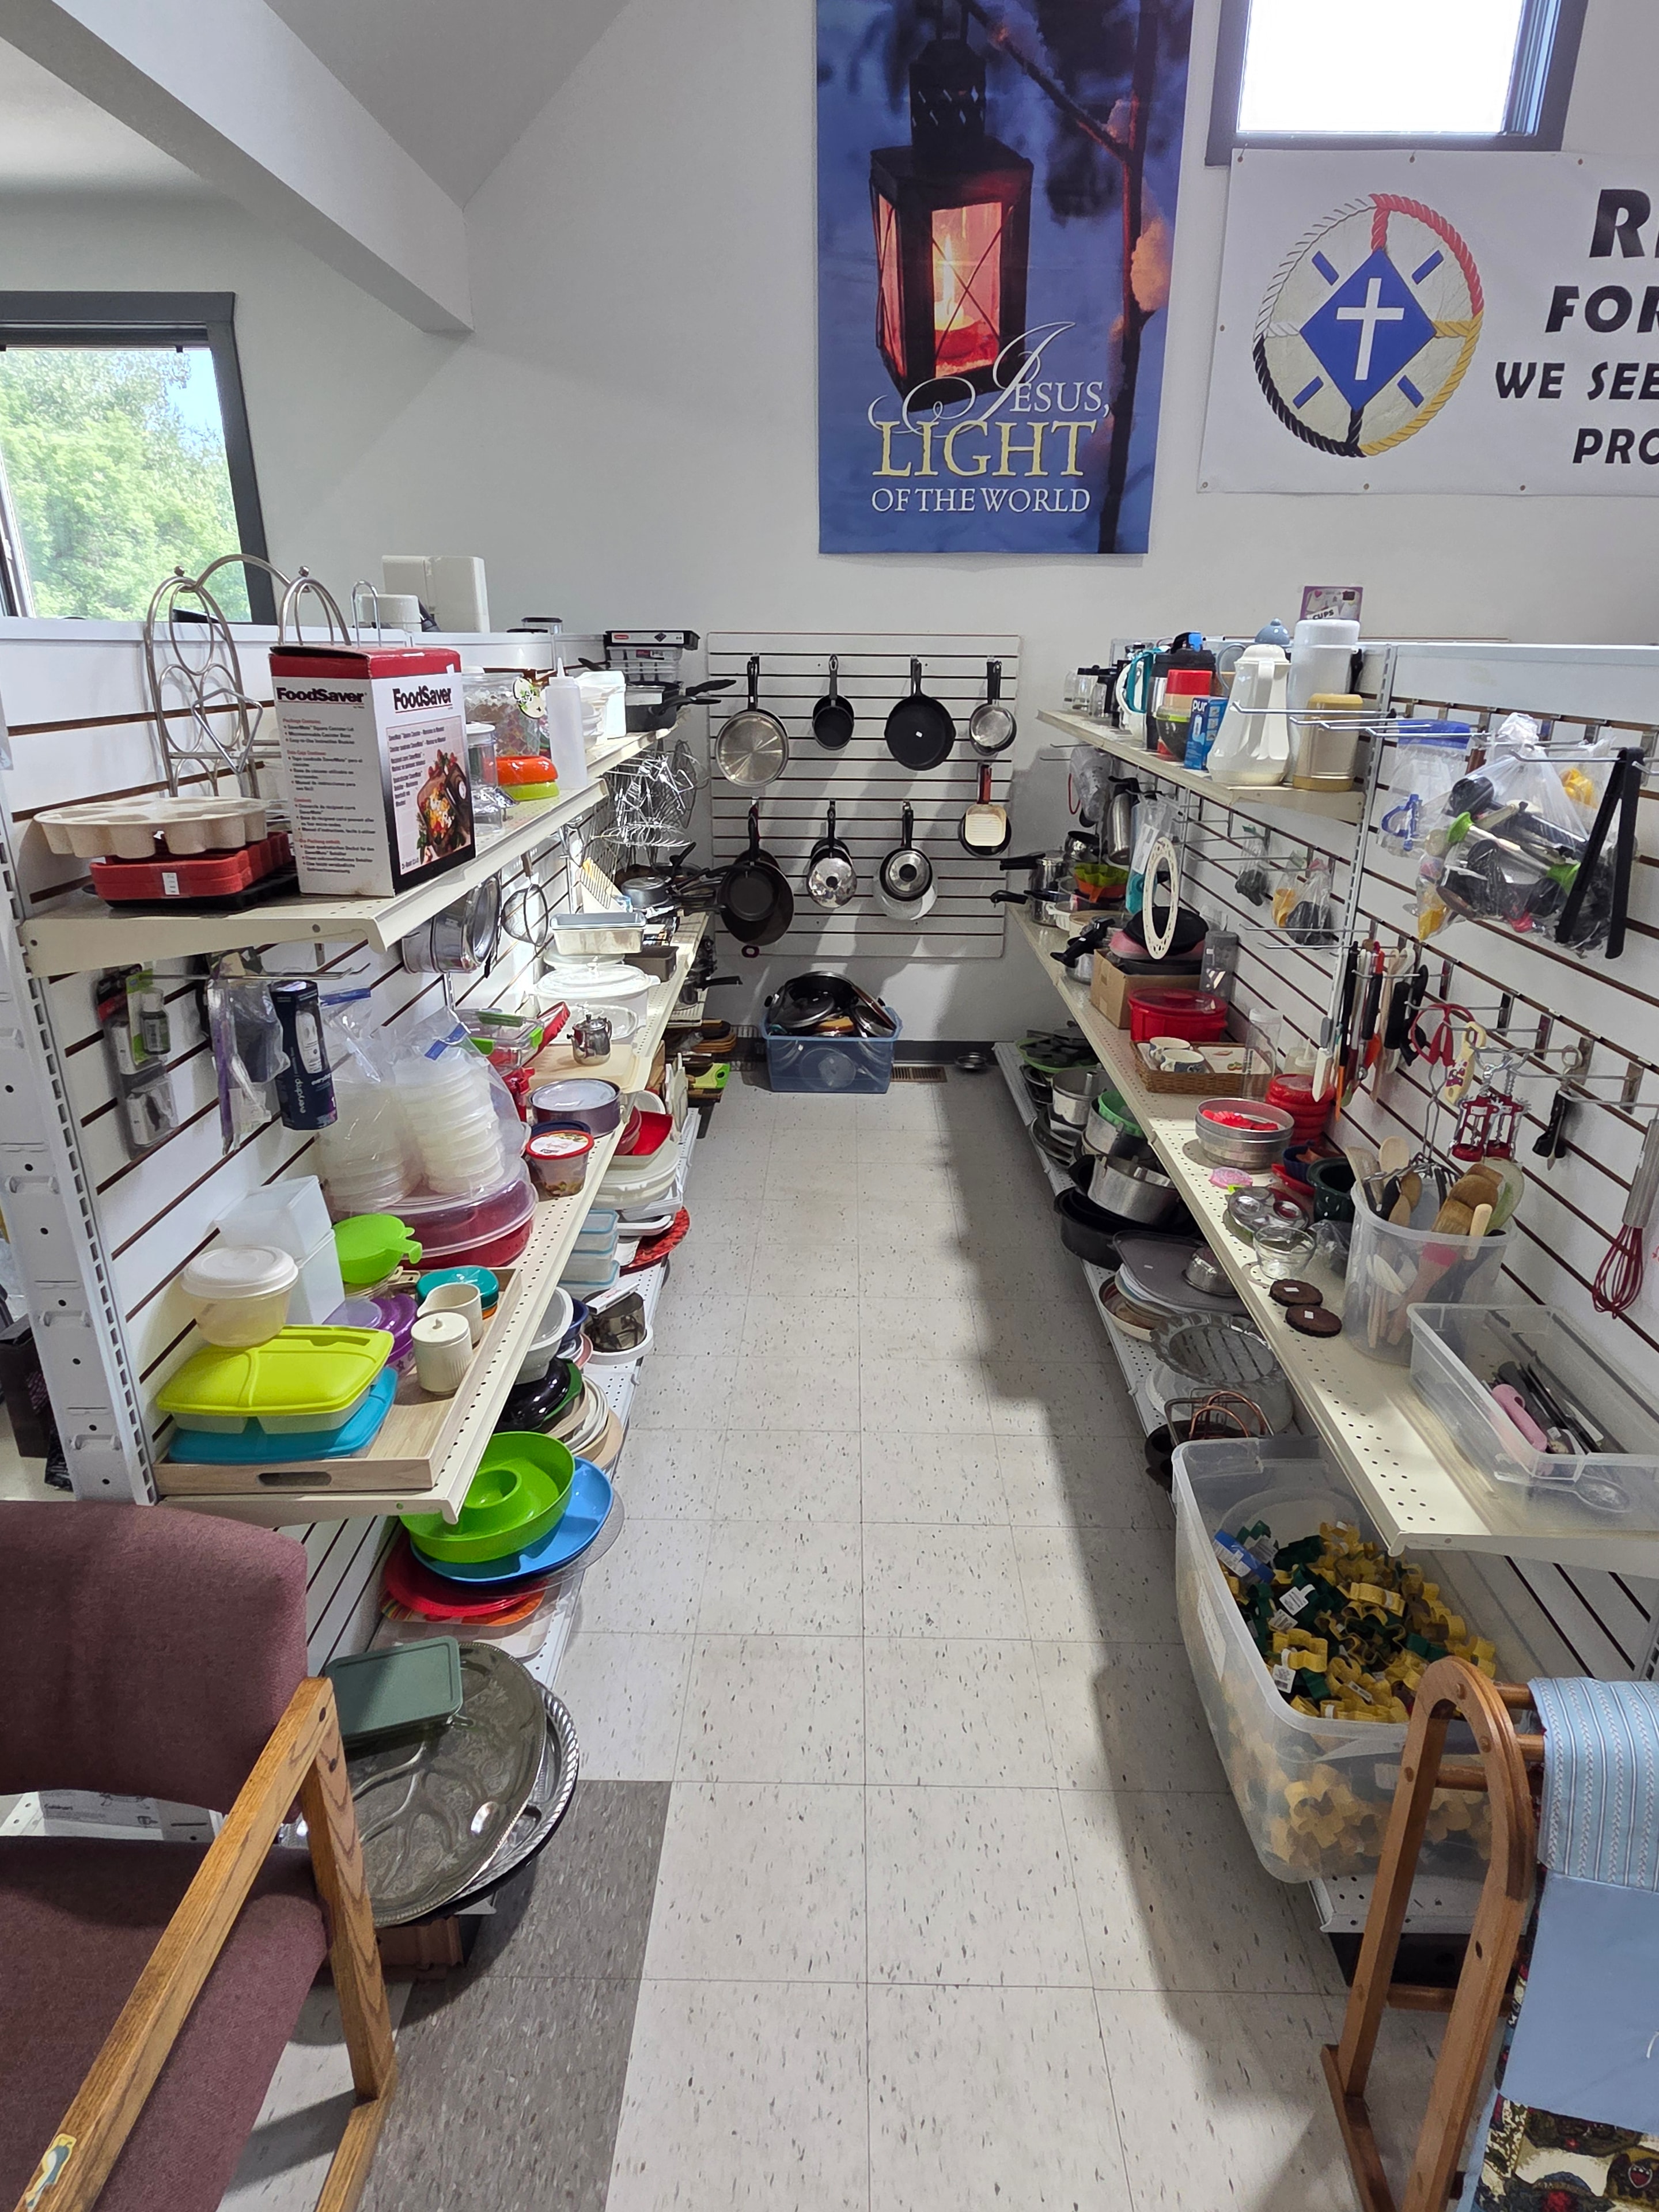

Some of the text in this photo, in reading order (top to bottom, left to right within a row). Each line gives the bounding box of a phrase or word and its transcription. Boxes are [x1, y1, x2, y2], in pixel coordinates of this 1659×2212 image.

[1589, 188, 1659, 258] R
[1495, 362, 1565, 399] WE
[872, 419, 1096, 477] LIGHT
[871, 487, 1091, 513] OF THE WORLD
[1312, 609, 1335, 620] CUPS
[276, 687, 365, 703] FoodSaver
[392, 685, 452, 711] FoodSaver
